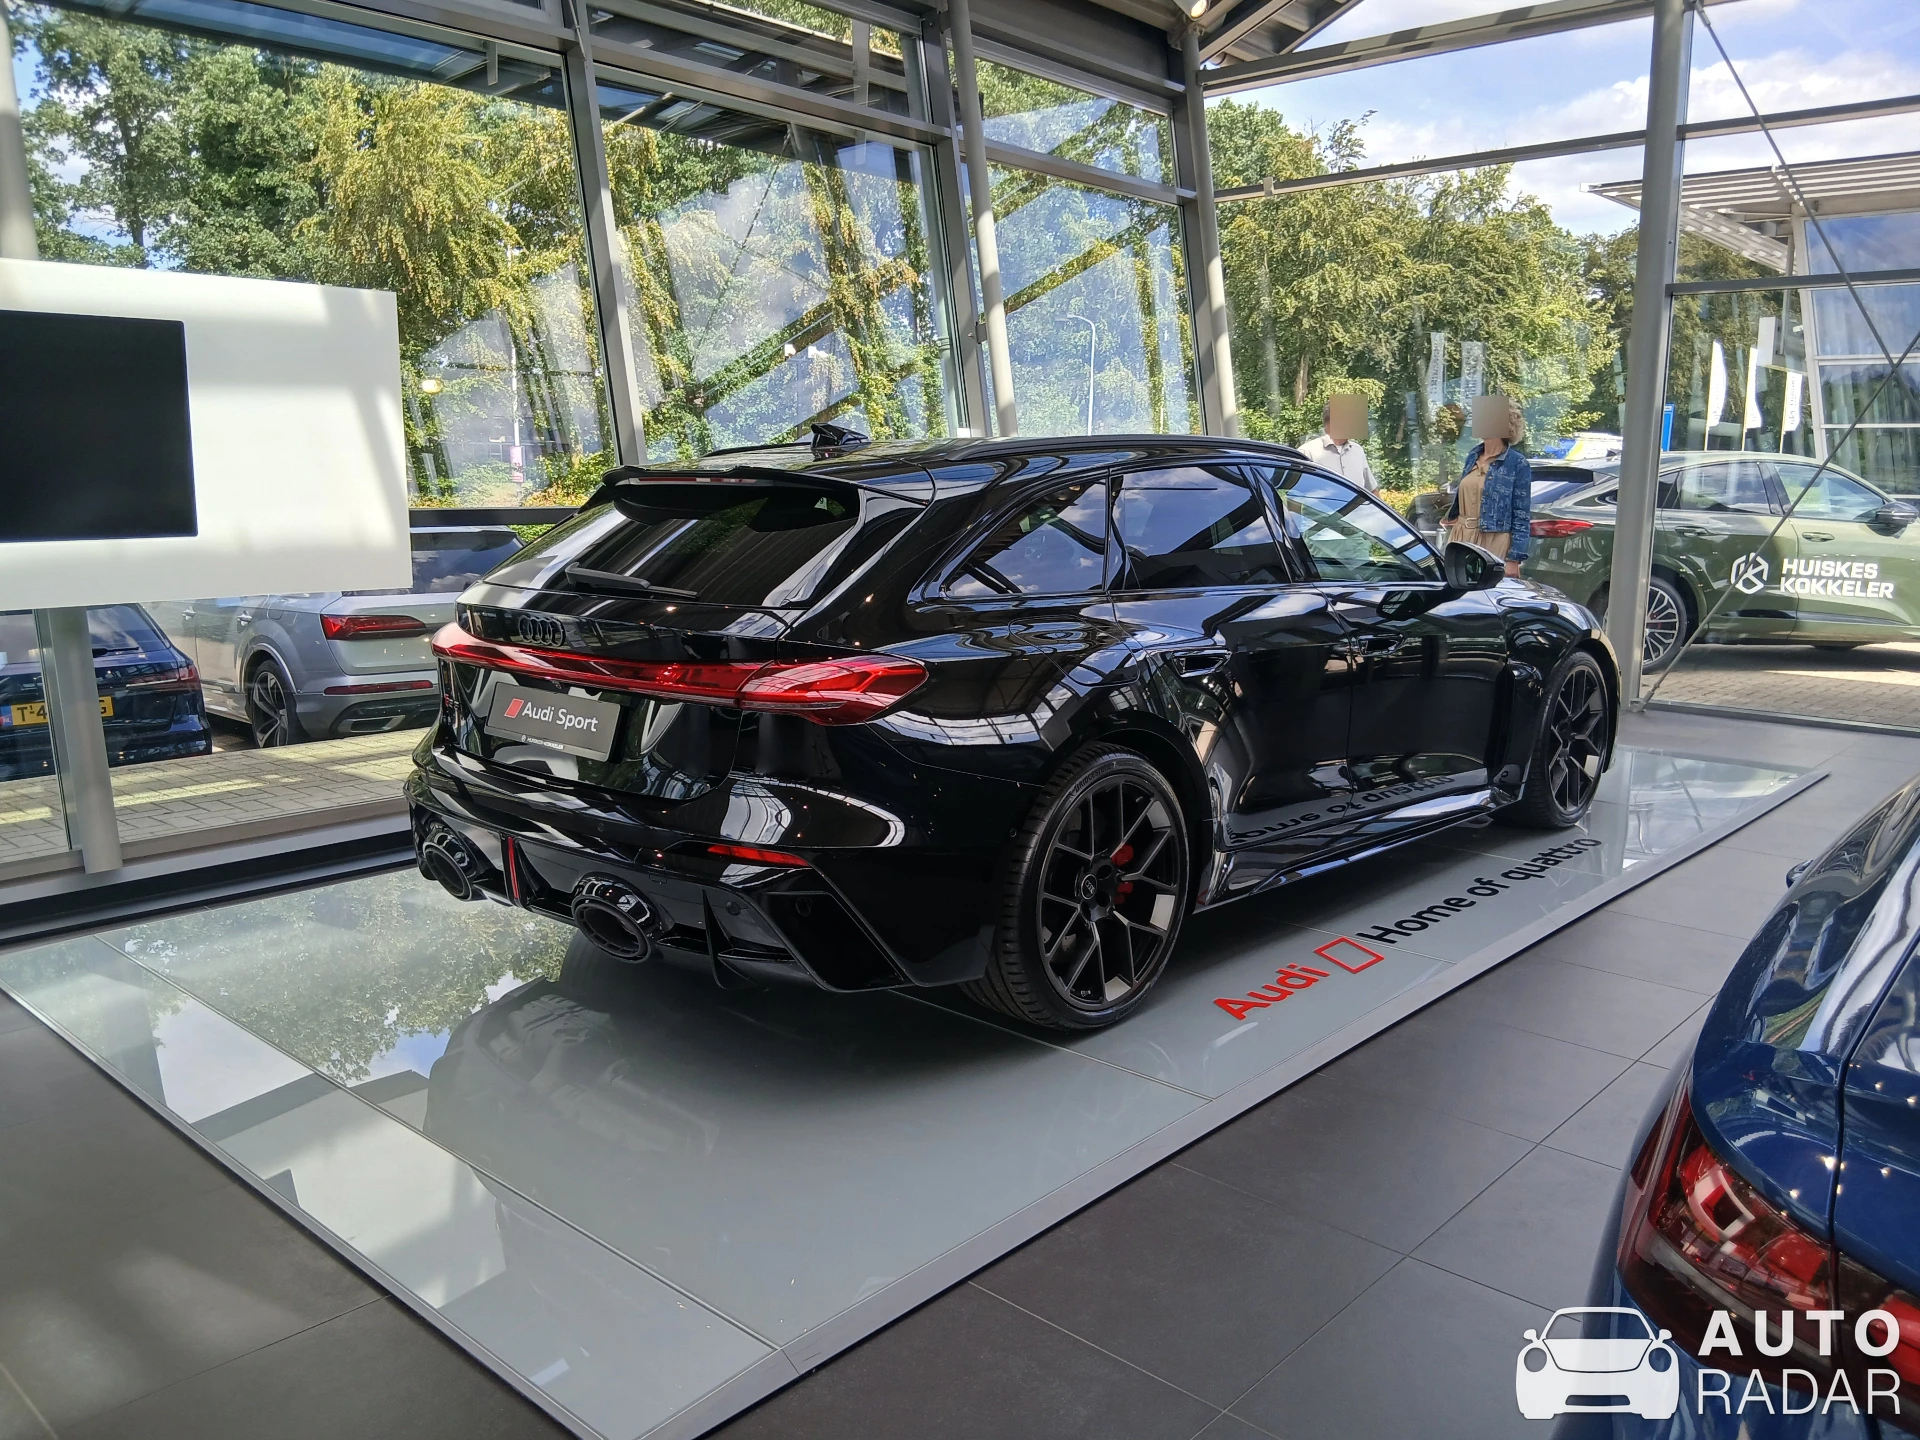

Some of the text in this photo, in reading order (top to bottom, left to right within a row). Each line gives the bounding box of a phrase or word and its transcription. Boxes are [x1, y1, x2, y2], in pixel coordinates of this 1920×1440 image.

[1781, 558, 1879, 579] HUISKES
[1780, 577, 1895, 599] KOKKELER
[521, 701, 599, 732] Audi Sport
[1213, 838, 1603, 1021] Audi Home of quattro
